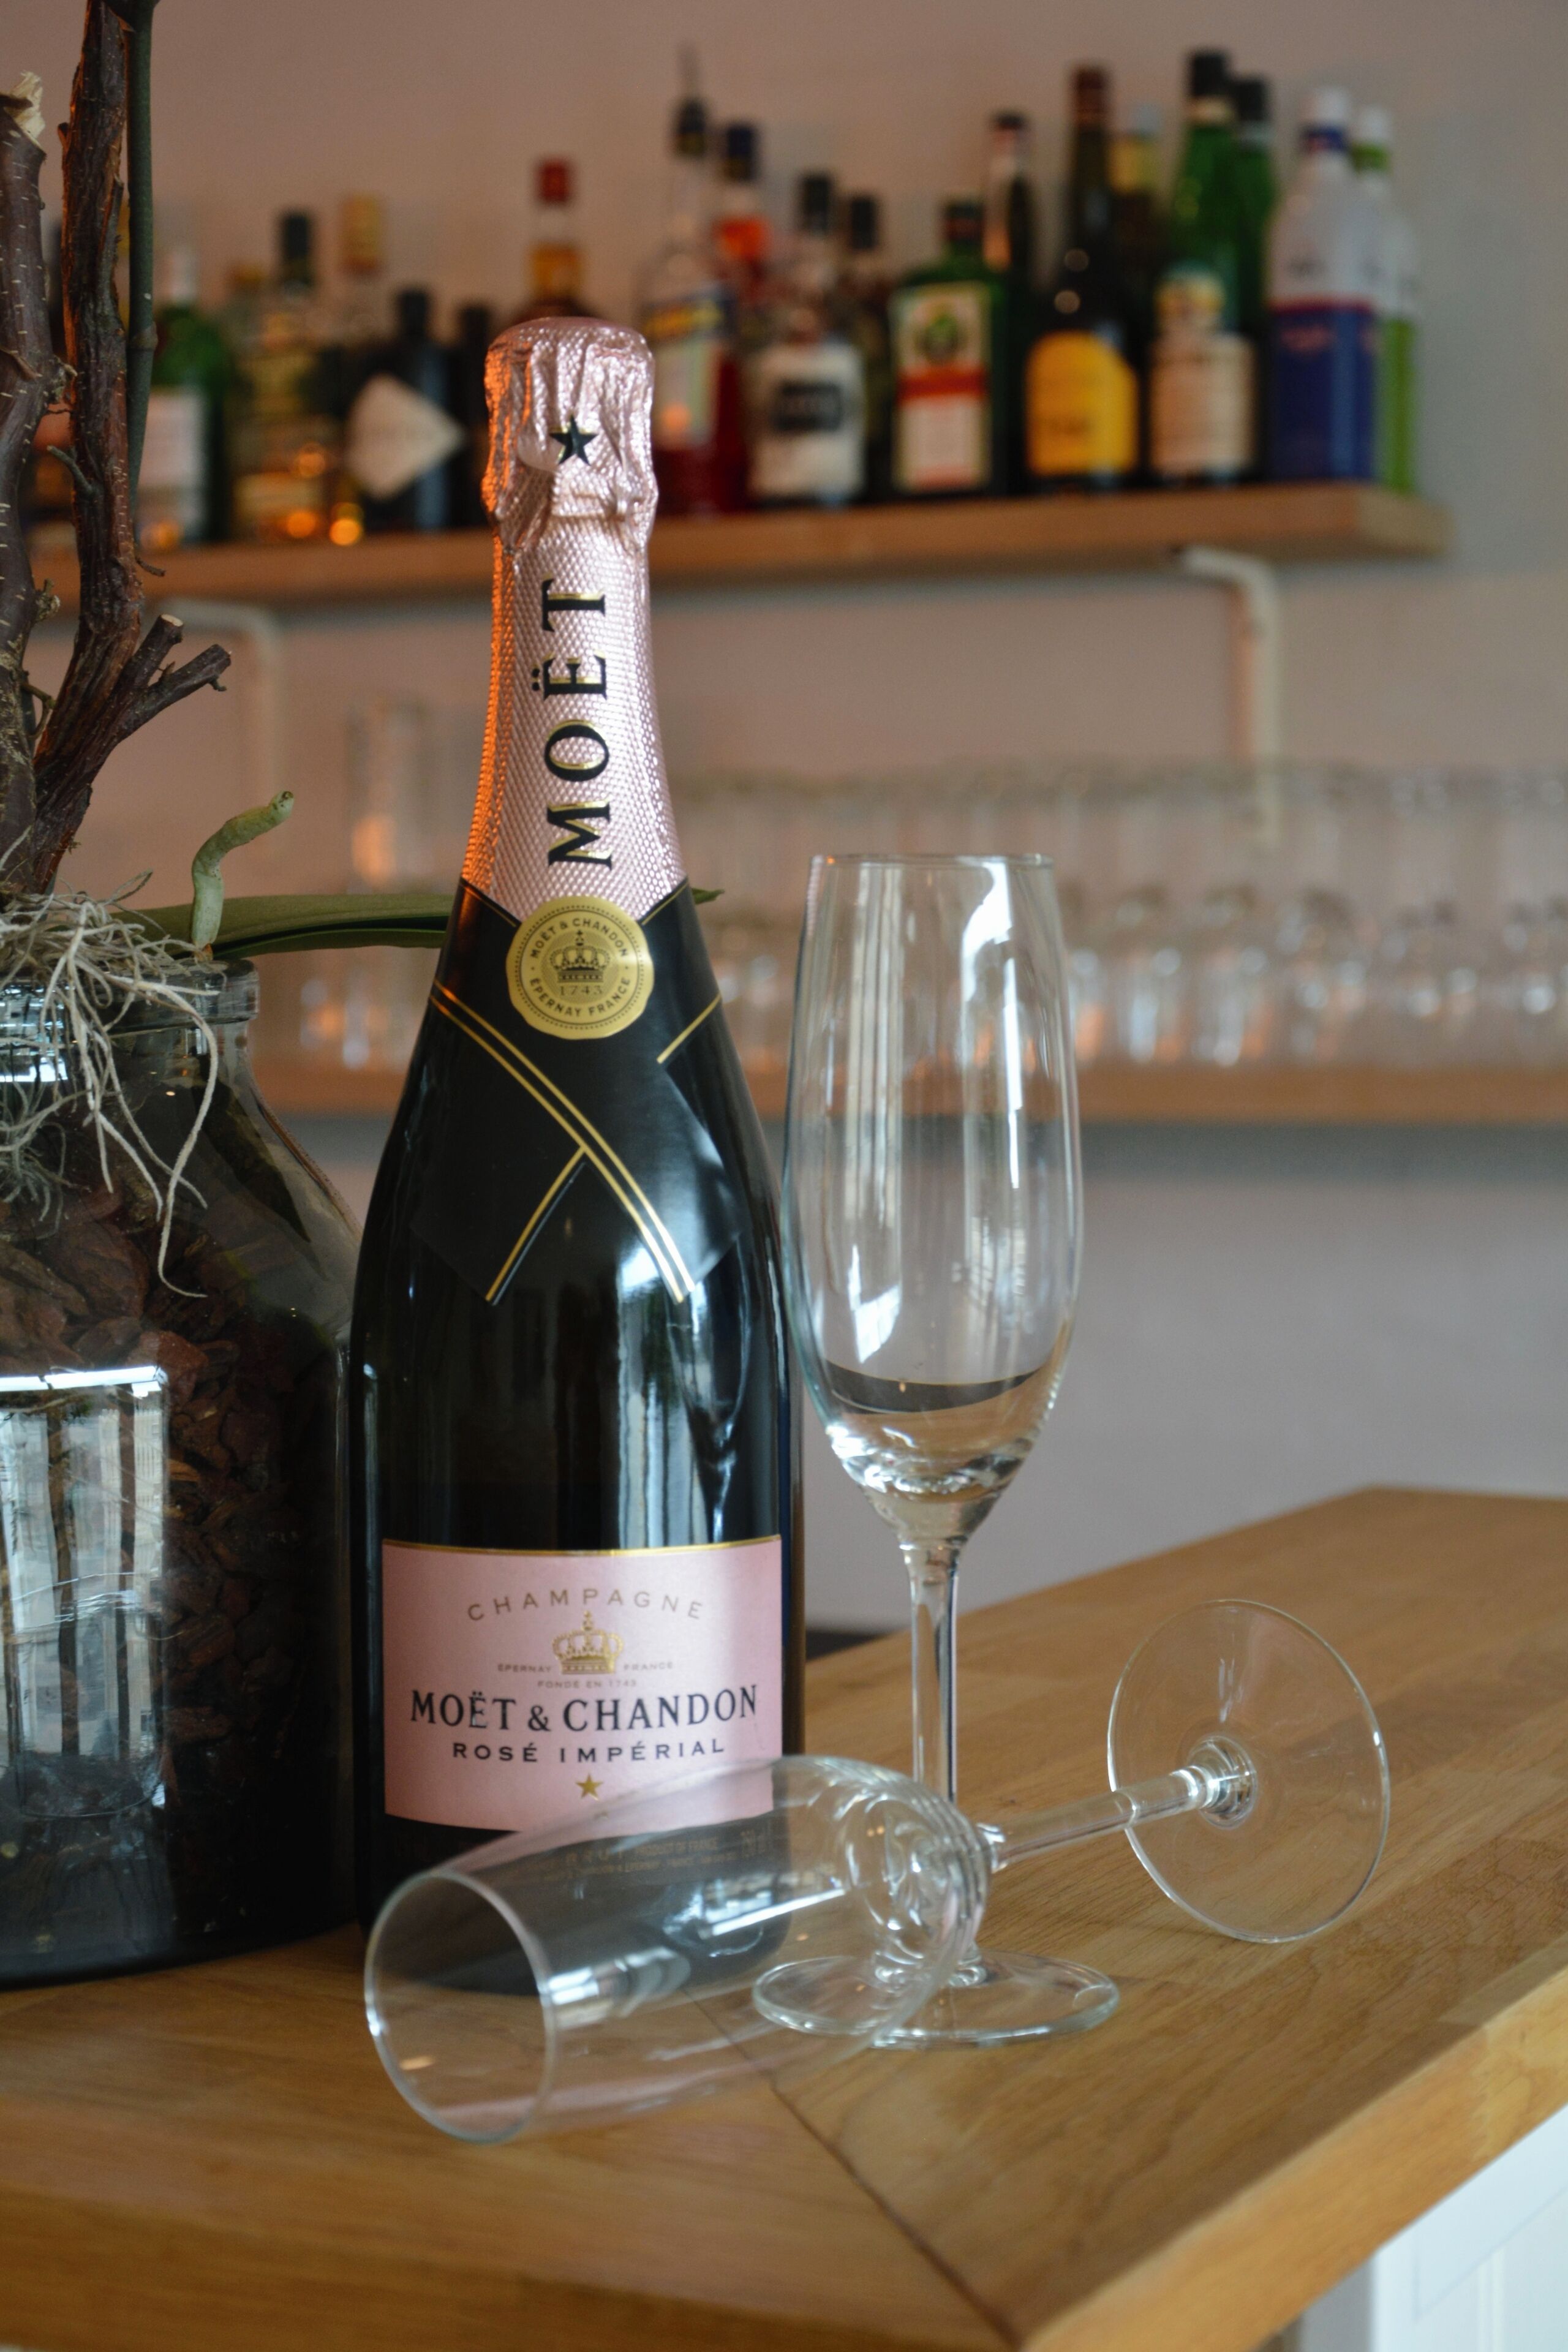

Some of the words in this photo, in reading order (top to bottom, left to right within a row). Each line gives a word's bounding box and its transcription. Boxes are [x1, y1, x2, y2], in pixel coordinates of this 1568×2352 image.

[532, 576, 613, 870] MOËT
[560, 921, 568, 930] &
[573, 918, 628, 957] CHANDON
[560, 985, 603, 996] 1743
[589, 979, 630, 1016] FRANCE
[467, 1589, 703, 1621] CHAMPAGNE
[624, 1662, 673, 1670] FRANCE
[609, 1679, 637, 1687] 1743
[410, 1689, 516, 1730] MOËT
[527, 1705, 551, 1732] &
[562, 1685, 756, 1732] CHANDON
[453, 1743, 537, 1762] ROSÉ
[560, 1738, 725, 1763] IMPÉRIAL
